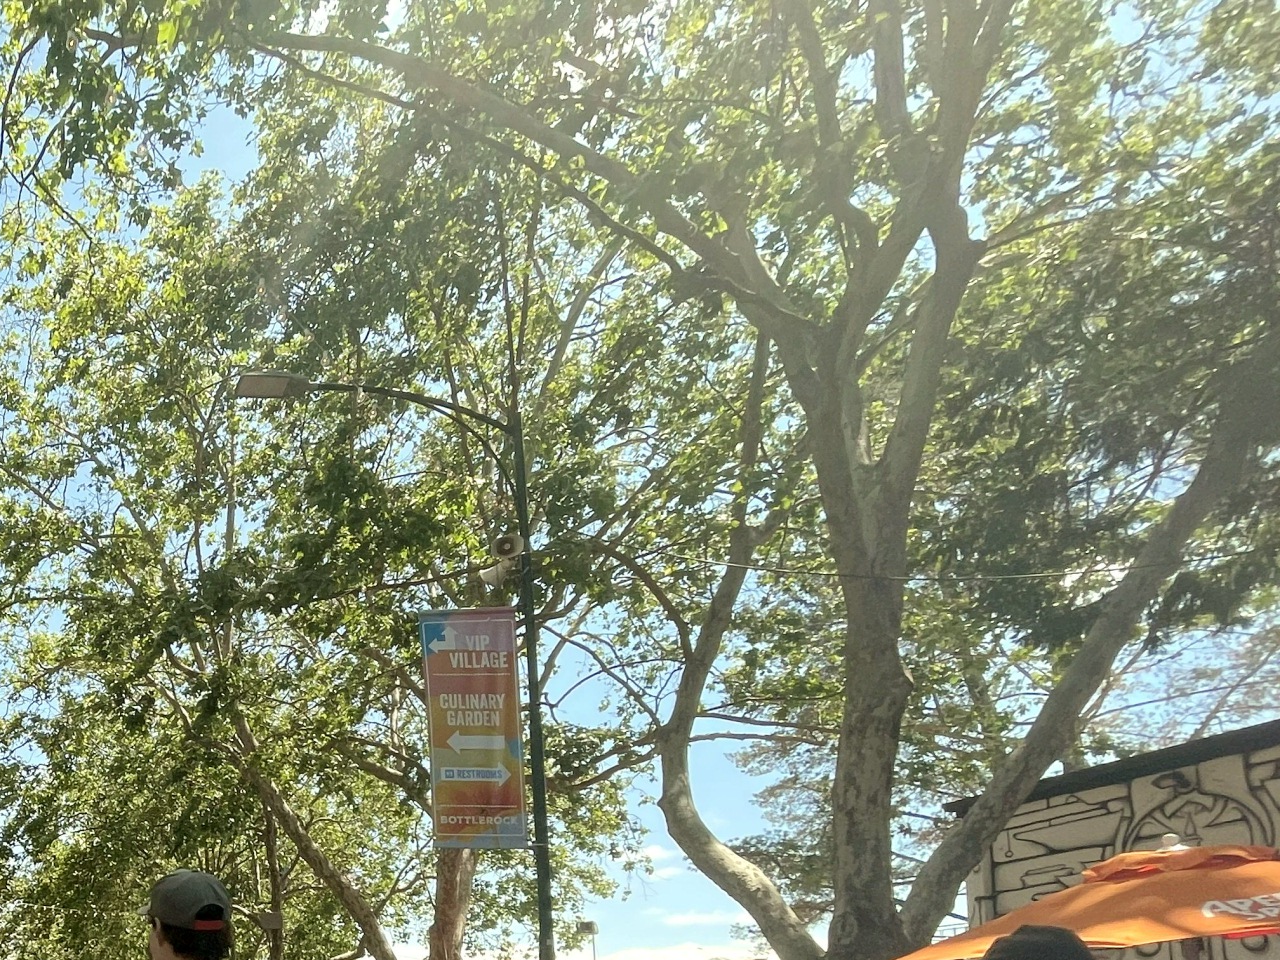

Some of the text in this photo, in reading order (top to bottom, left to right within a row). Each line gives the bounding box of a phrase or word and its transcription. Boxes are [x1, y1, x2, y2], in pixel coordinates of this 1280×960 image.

[465, 635, 489, 651] VIP
[449, 652, 508, 668] VILLAGE
[440, 693, 505, 709] CULINARY
[447, 711, 500, 726] GARDEN
[456, 769, 503, 779] RESTROOMS
[440, 815, 519, 825] BOTTLEROCK
[1201, 892, 1280, 917] APE
